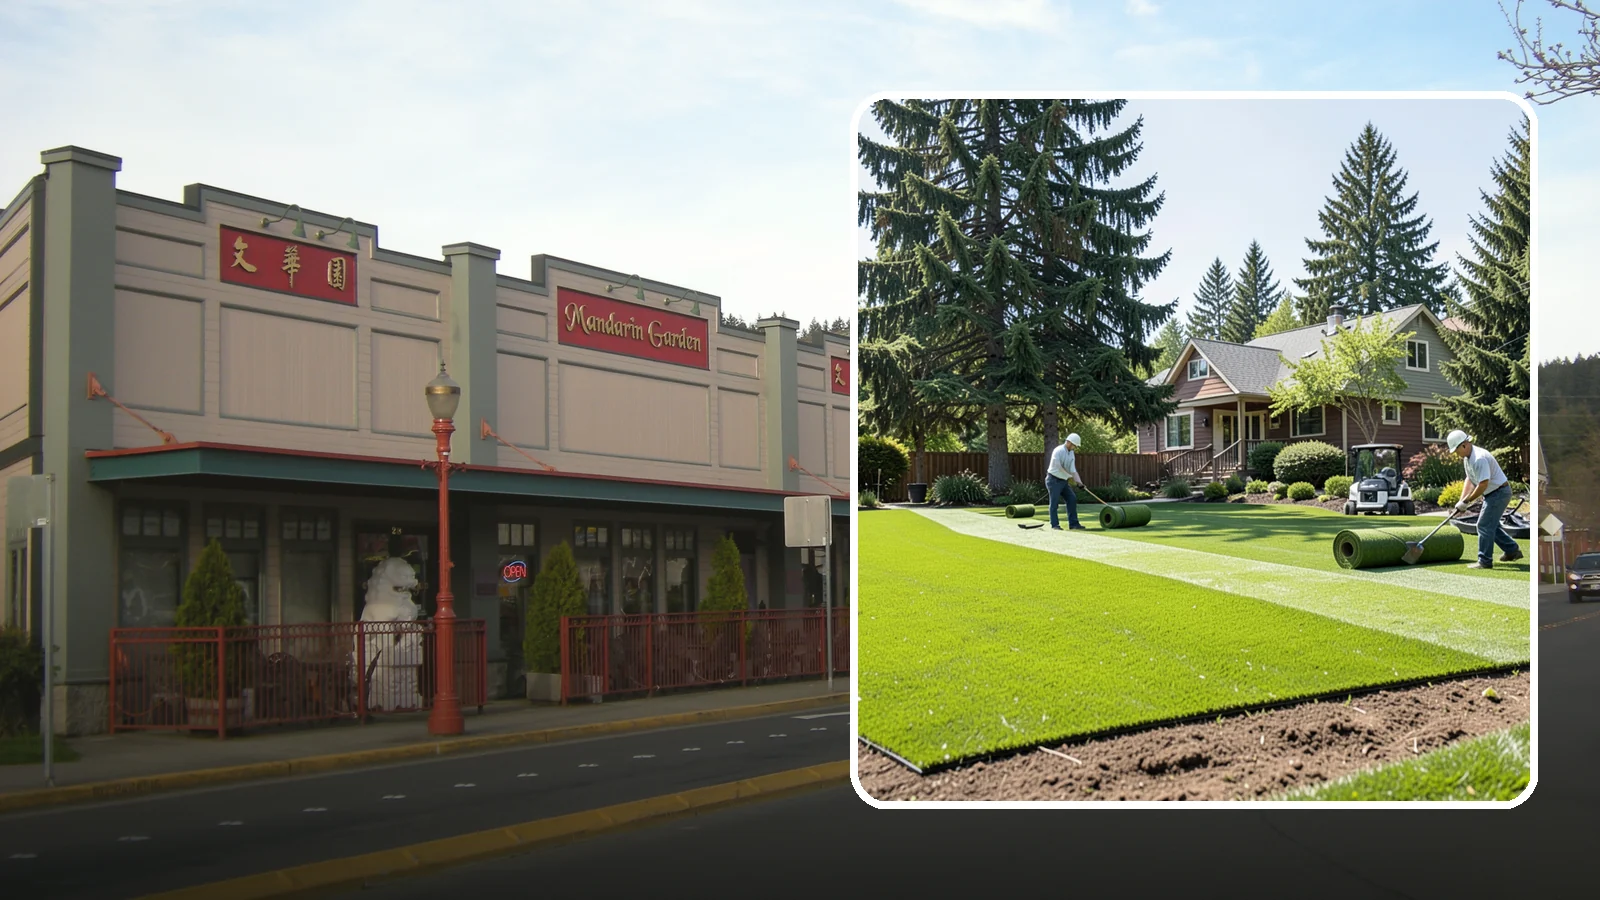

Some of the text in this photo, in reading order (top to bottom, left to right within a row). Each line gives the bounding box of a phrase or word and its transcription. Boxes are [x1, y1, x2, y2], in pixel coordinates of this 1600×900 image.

[565, 303, 701, 351] Mandarin Garden
[503, 565, 526, 578] OPEN
